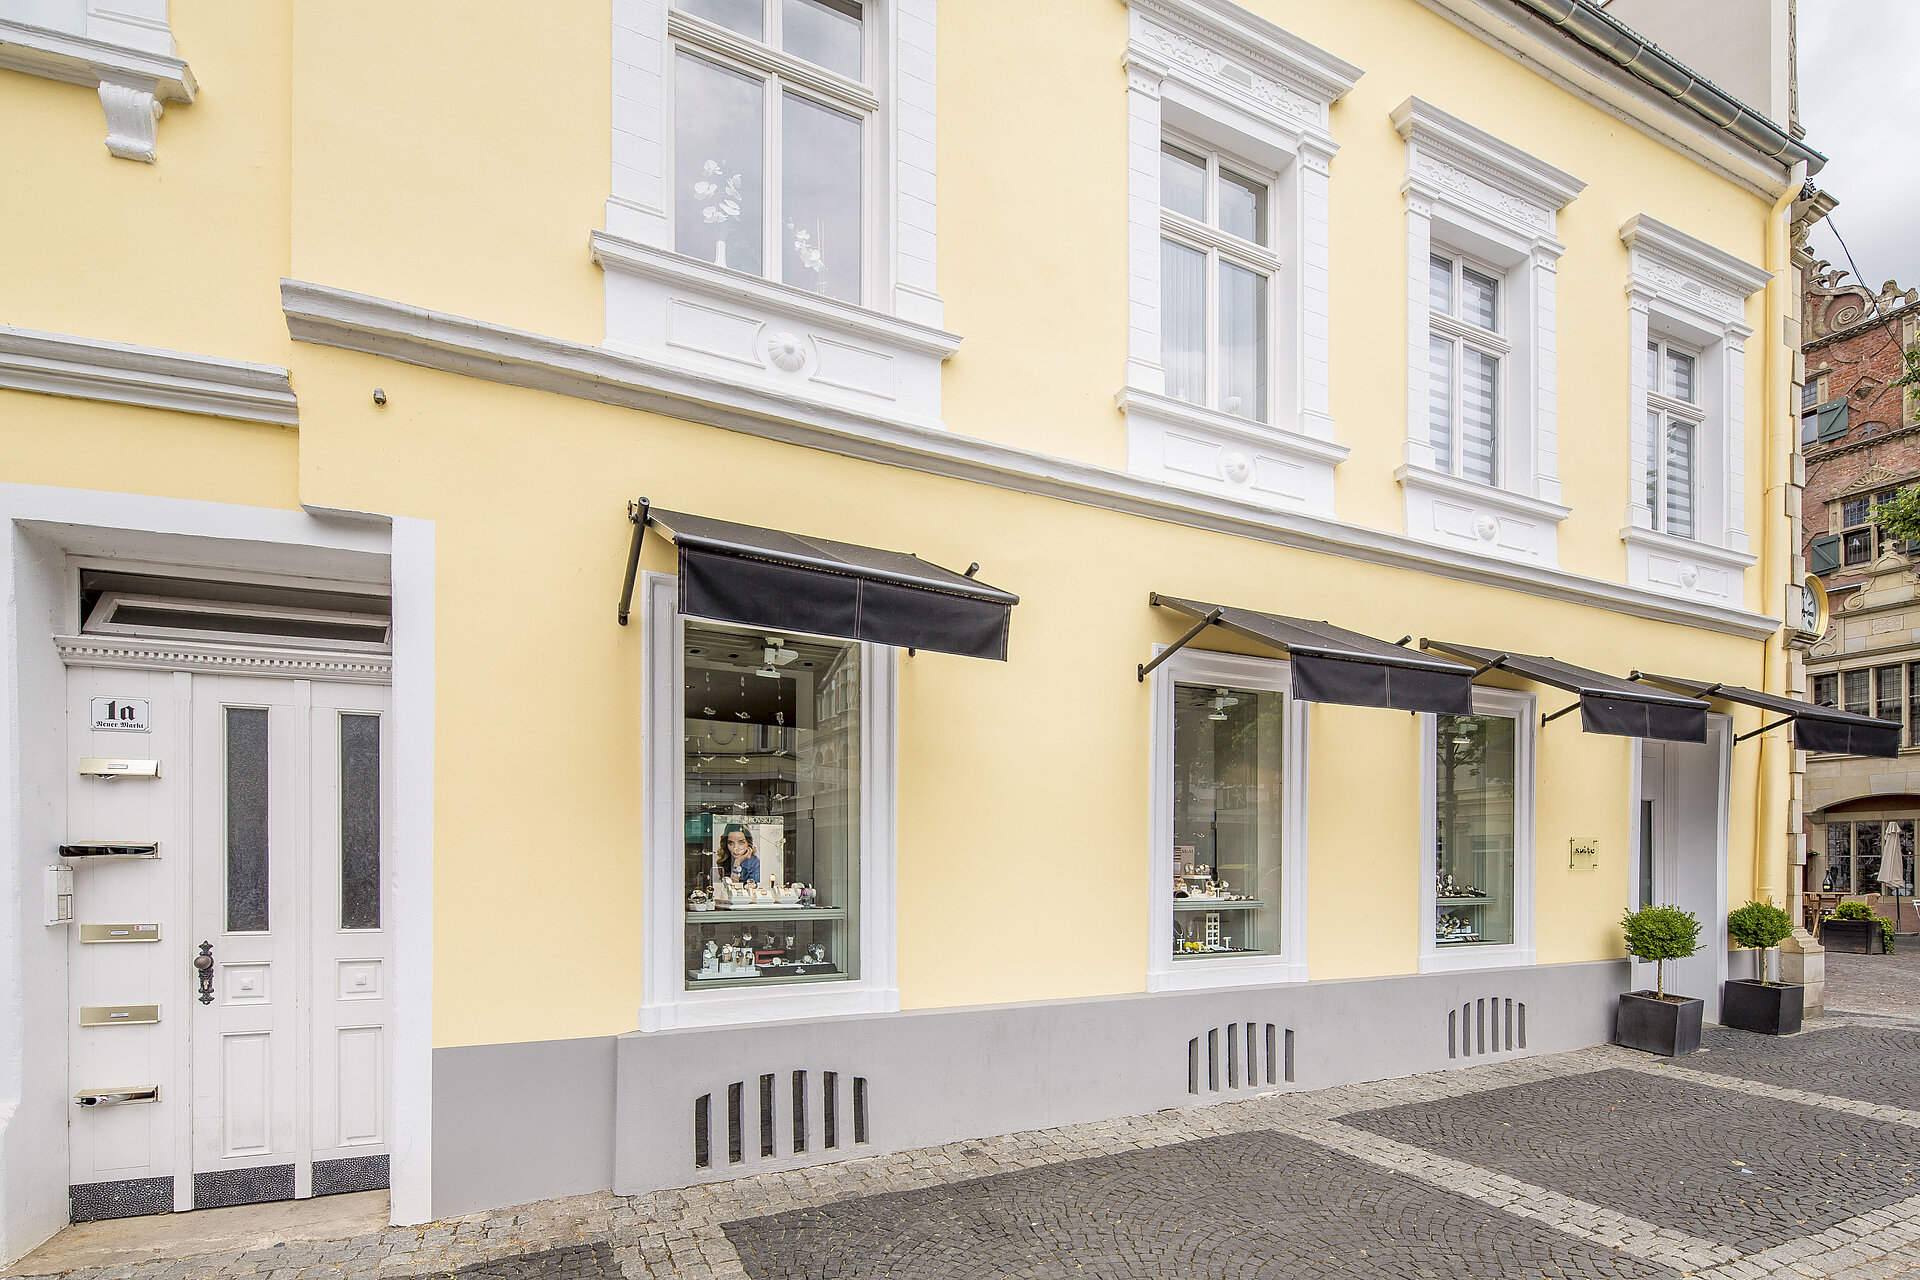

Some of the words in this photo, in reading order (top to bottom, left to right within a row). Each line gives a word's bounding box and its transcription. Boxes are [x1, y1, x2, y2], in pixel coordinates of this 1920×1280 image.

[104, 700, 135, 721] 1a
[95, 720, 118, 728] Neuer
[120, 721, 144, 729] Markt
